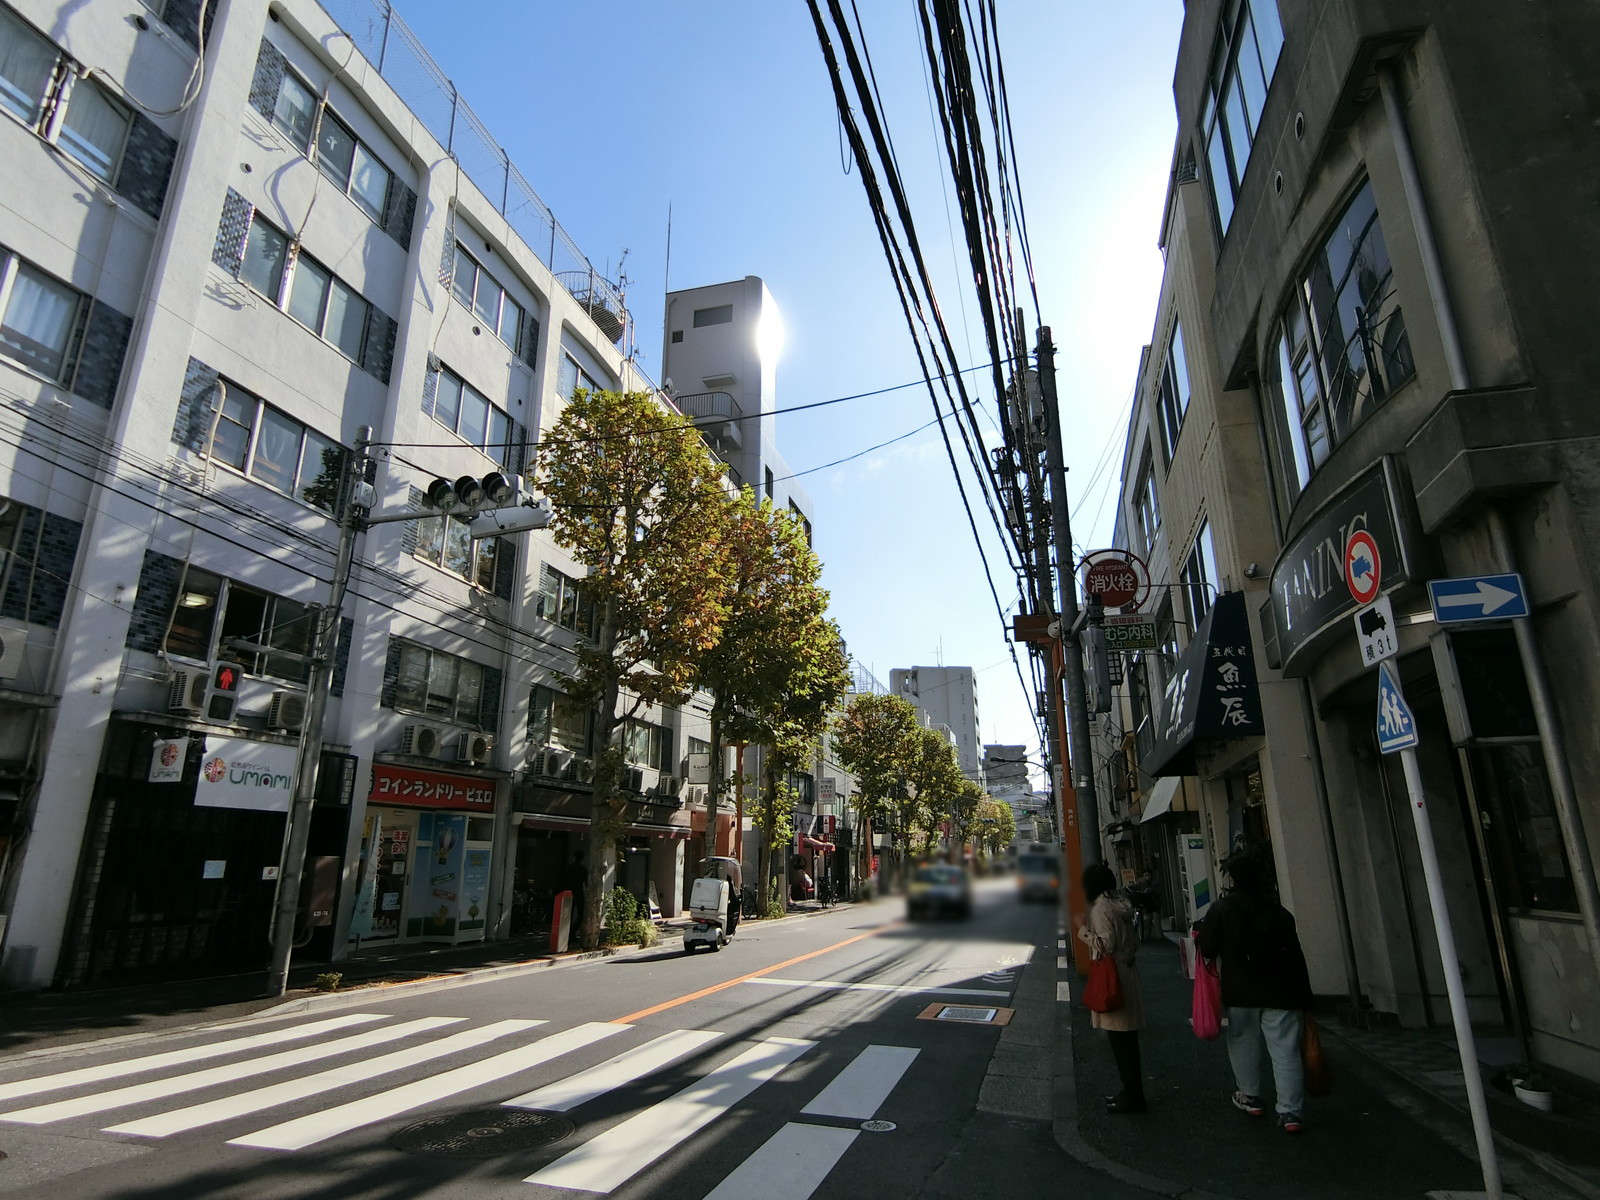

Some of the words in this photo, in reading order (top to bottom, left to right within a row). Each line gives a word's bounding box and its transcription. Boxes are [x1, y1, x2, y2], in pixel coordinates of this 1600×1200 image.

[1090, 573, 1135, 592] 消火栓
[1211, 646, 1247, 658] 五代目
[1216, 661, 1252, 726] 魚辰
[230, 769, 291, 789] UMAMI
[379, 777, 464, 800] コインランドリー
